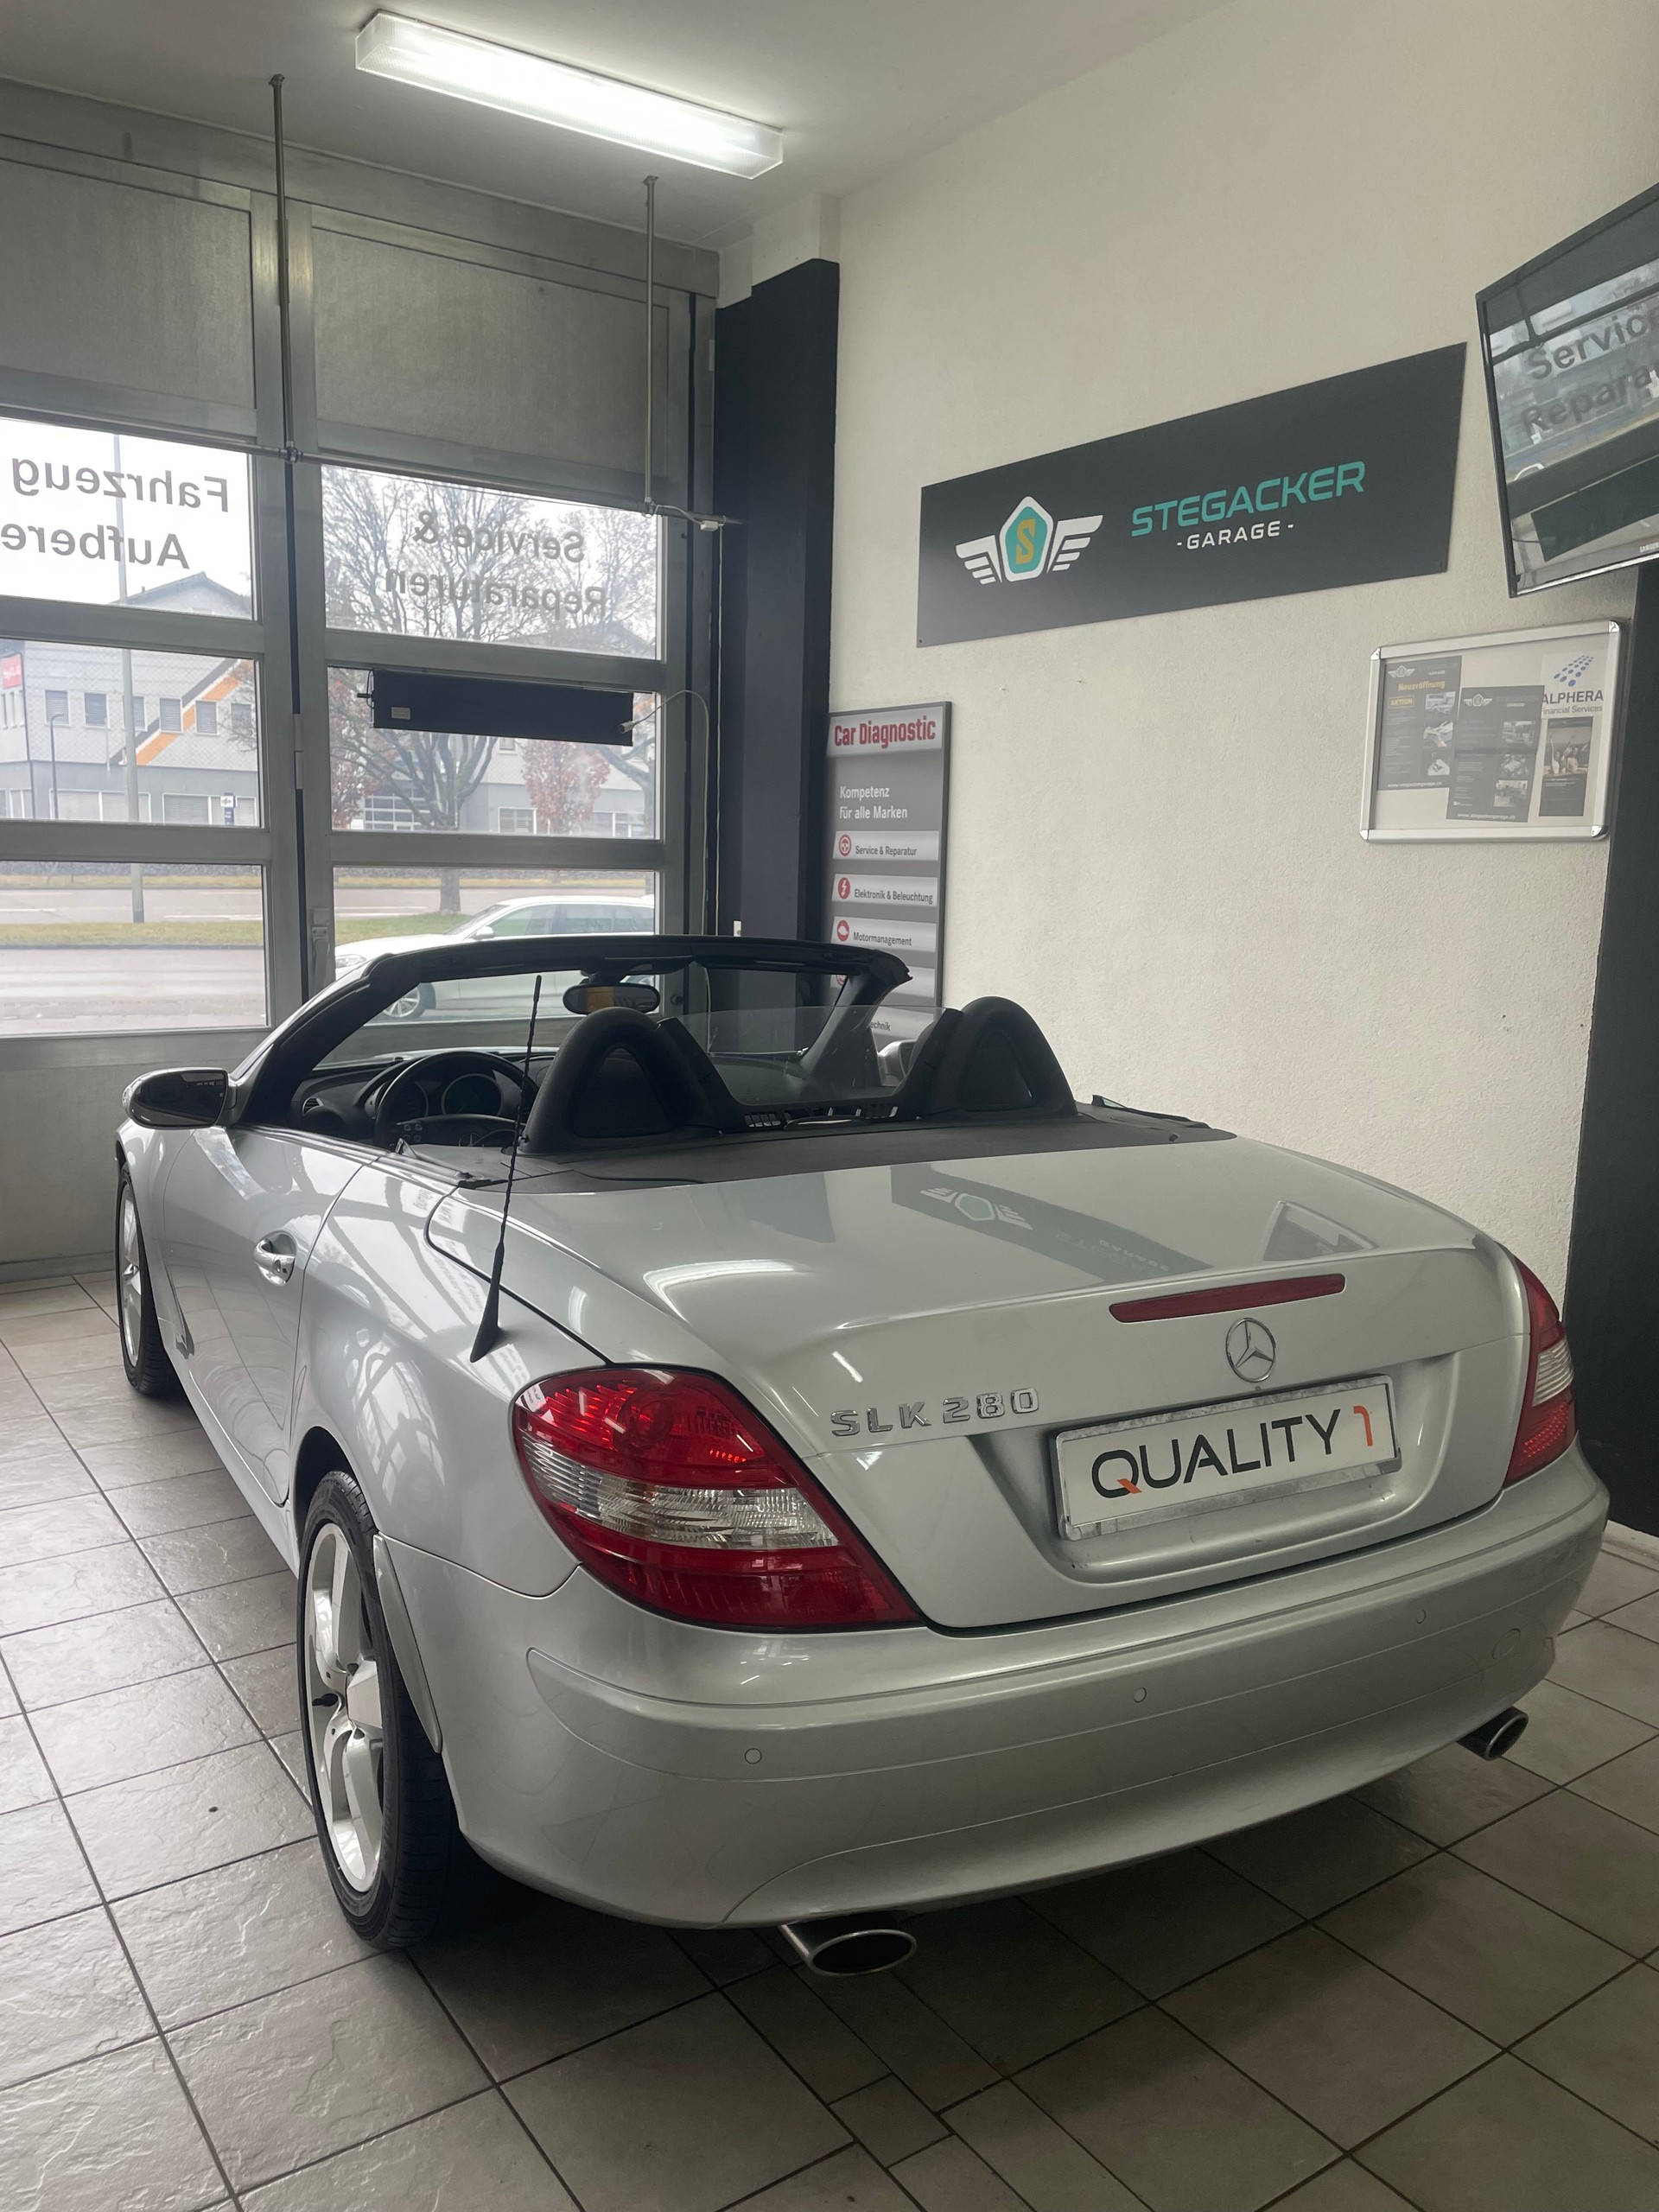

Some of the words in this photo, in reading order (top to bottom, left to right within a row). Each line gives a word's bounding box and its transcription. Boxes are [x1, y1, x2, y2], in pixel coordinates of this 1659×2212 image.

[1130, 461, 1366, 537] STEGACKER
[1541, 690, 1605, 705] ALPHERA
[1571, 704, 1604, 714] Services
[834, 724, 856, 747] Car
[859, 715, 937, 749] Diagnostic
[840, 785, 890, 801] Kompetenz
[839, 805, 853, 819] für
[855, 805, 871, 819] alle
[873, 804, 908, 819] Marken
[855, 845, 879, 855] Service
[879, 846, 884, 855] &
[885, 846, 918, 857] Reparatur
[854, 888, 886, 899] Elektronik
[887, 890, 892, 899] &
[892, 890, 933, 905] Beleuchtung
[853, 931, 912, 947] Motormanagement
[870, 1020, 891, 1032] echnik
[830, 1402, 932, 1437] SLK
[942, 1388, 1039, 1424] 280
[1091, 1408, 1341, 1499] QUALITY
